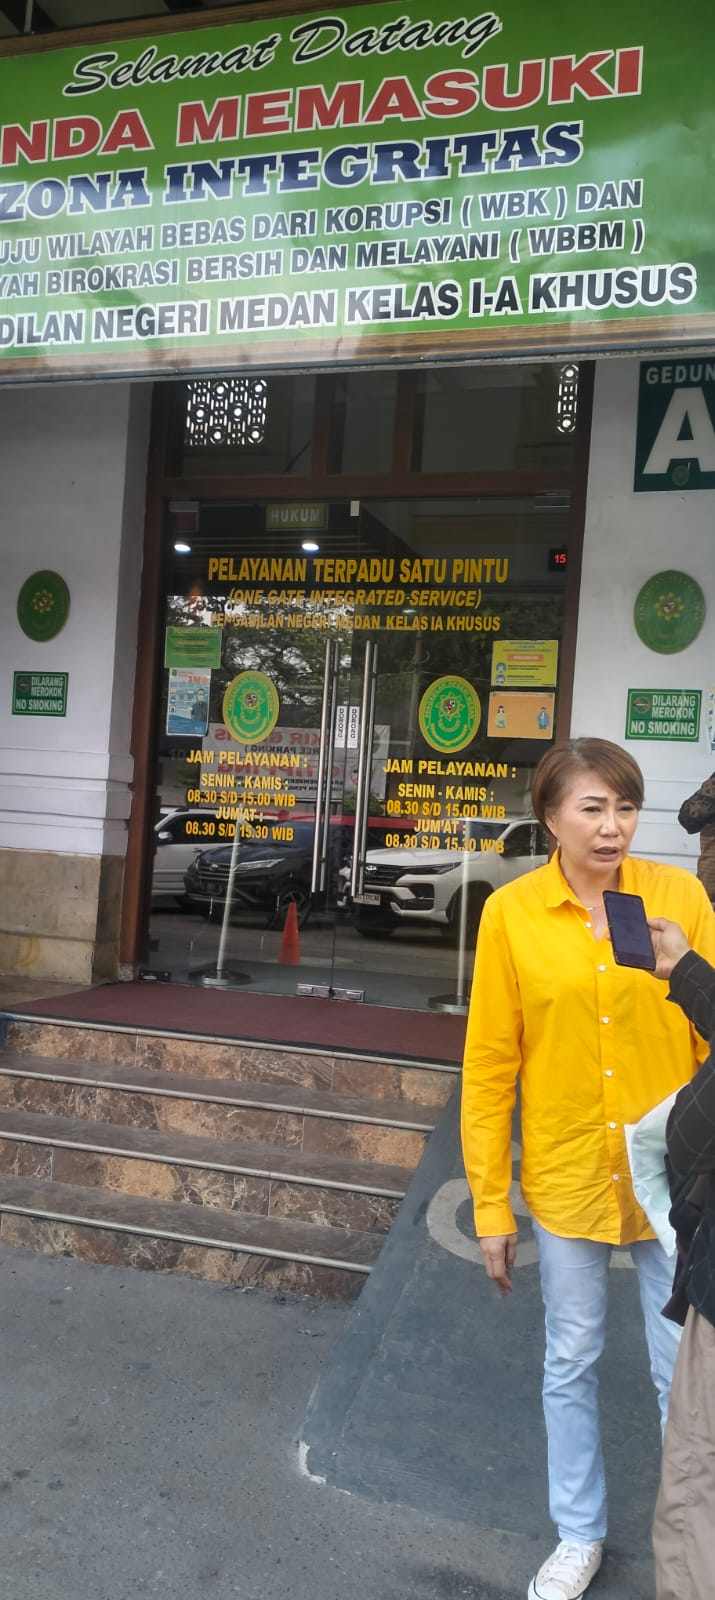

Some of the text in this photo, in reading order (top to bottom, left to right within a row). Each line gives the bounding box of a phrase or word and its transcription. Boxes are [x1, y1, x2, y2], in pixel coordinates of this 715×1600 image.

[63, 11, 502, 95] Selamat Datang
[176, 46, 643, 147] MEMASUKI
[0, 120, 584, 223] ZONA INTEGRITAS
[47, 224, 153, 260] WILAYAH
[160, 217, 246, 249] BEBAS
[252, 208, 318, 241] DARI
[324, 197, 452, 235] KORUPSI
[479, 188, 552, 222] WBK
[576, 178, 644, 212] DAN
[46, 257, 179, 296] BIROKRASI
[186, 249, 284, 285] BERSIH
[290, 243, 348, 275] DAN
[355, 231, 500, 270] MELAYANI
[527, 220, 626, 257] WBBM
[91, 299, 210, 344] NEGERI
[216, 289, 339, 335] MEDAN
[345, 279, 462, 326] KELAS
[468, 274, 523, 318] I-A
[528, 261, 697, 314] KHUSUS
[642, 386, 715, 475] A
[271, 508, 320, 523] HUKUM
[554, 553, 567, 564] 15
[208, 557, 509, 584] PELAYANAN TERPADU SATU PINTU
[228, 587, 482, 609] (ONE GATE INTEGRATED SERVICE)
[210, 612, 501, 631] PENGADILAN NEGERI MEDAN KELAS IA KHUSUS
[31, 676, 64, 687] DILARANG
[31, 686, 62, 697] MEROKOK
[652, 694, 696, 707] DILARANG
[15, 698, 63, 711] NO SMOKING
[651, 707, 695, 719] MEROKOK
[631, 721, 695, 735] NO SMOKING
[186, 749, 215, 764] JAM
[219, 751, 300, 768] PELAYANAN
[383, 759, 413, 774] JAM
[418, 760, 508, 778] PELAYANAN
[201, 773, 235, 787] SENIN
[244, 776, 282, 790] KAMIS
[187, 788, 296, 808] 08.30 S/D 15.00 WIB
[398, 783, 435, 799] SENIN
[445, 786, 487, 801] KAMIS
[386, 799, 506, 819] 08.30 S/D 15.00 WIB
[186, 820, 294, 841] 08.30 S/D 15.30 WIB
[414, 818, 460, 834] JUM'AT
[385, 833, 418, 848] 08.30
[421, 836, 440, 850] S/D
[480, 838, 505, 854] WIB
